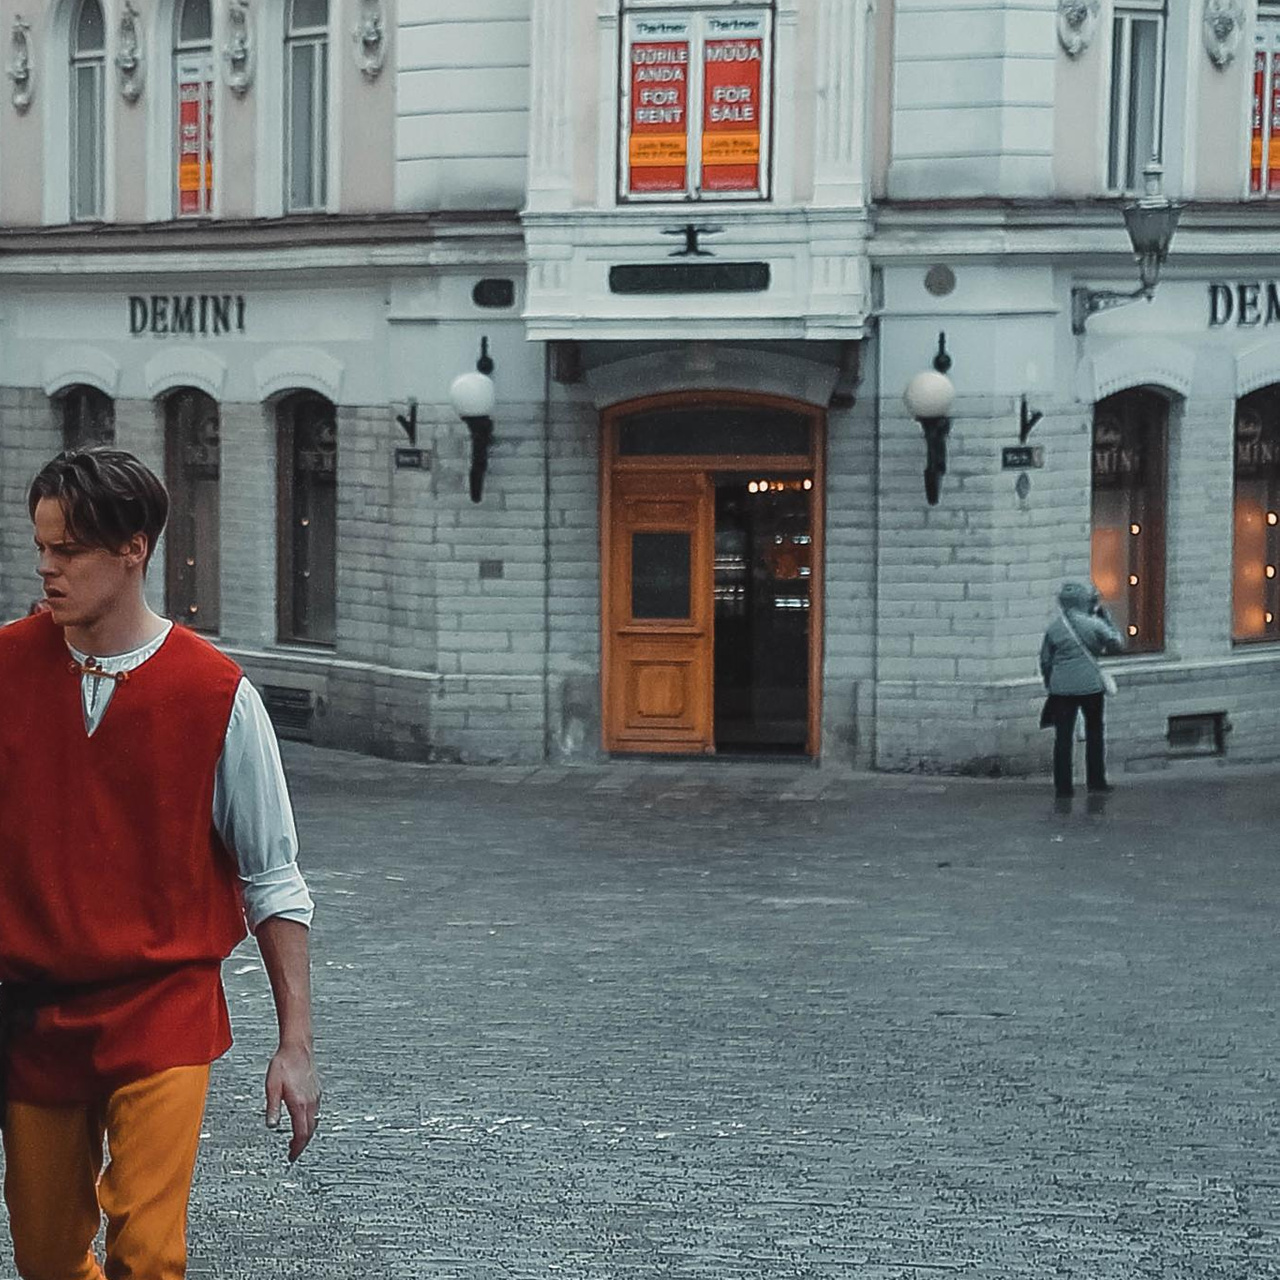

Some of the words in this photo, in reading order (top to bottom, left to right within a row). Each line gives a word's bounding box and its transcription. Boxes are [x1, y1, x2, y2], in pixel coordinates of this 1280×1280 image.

[641, 88, 678, 105] FOR
[714, 86, 751, 103] FOR
[636, 107, 683, 124] RENT
[710, 104, 754, 122] SALE
[128, 295, 245, 334] DEMINI
